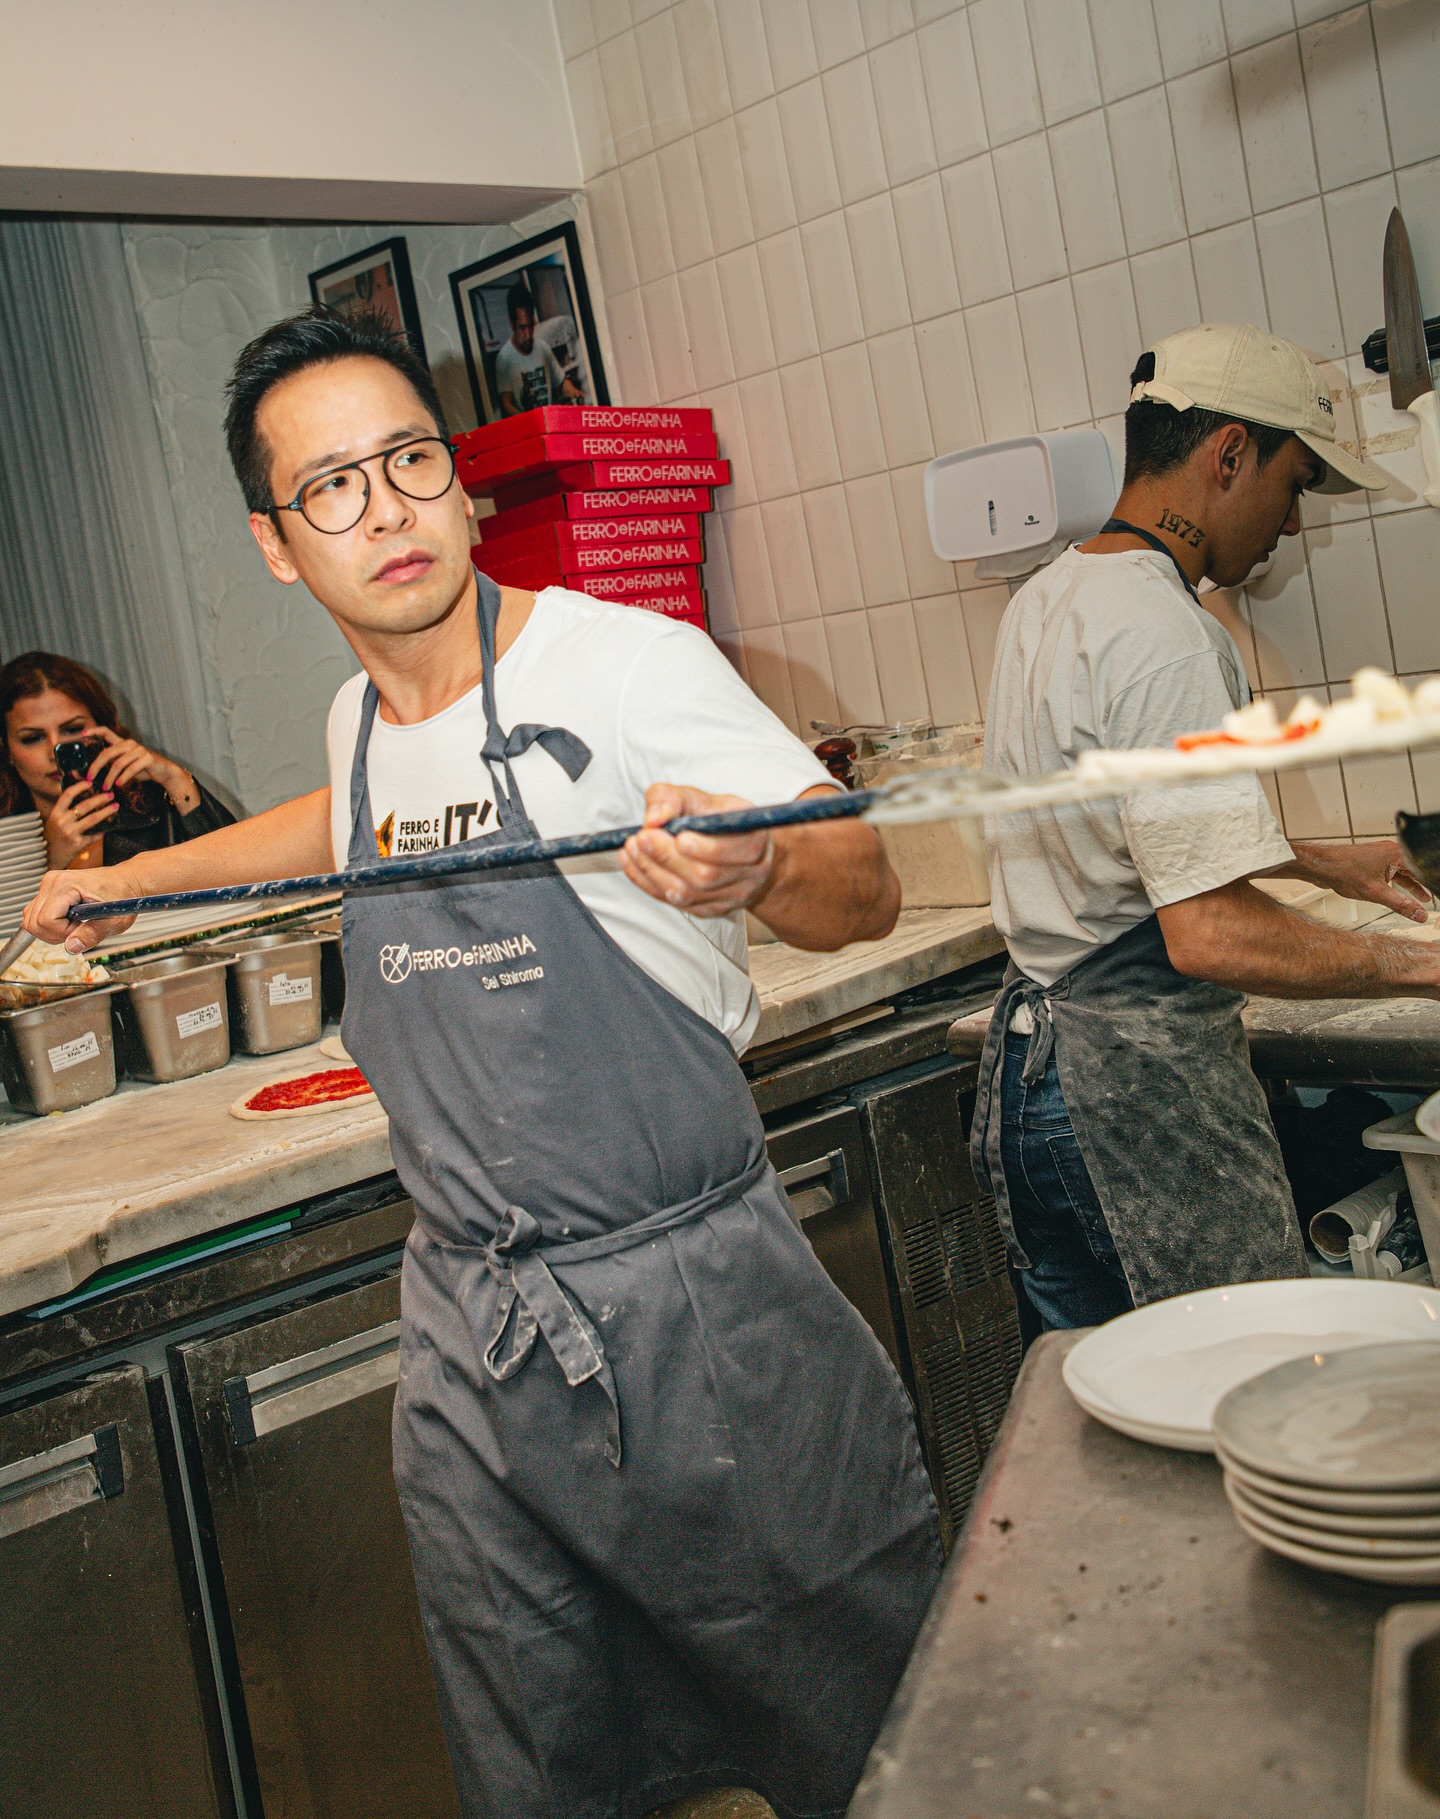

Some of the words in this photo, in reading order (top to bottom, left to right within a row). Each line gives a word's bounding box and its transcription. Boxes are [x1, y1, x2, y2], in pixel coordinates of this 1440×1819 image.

[400, 820, 431, 836] FERRO
[433, 818, 440, 833] E
[397, 837, 440, 853] FARINHA
